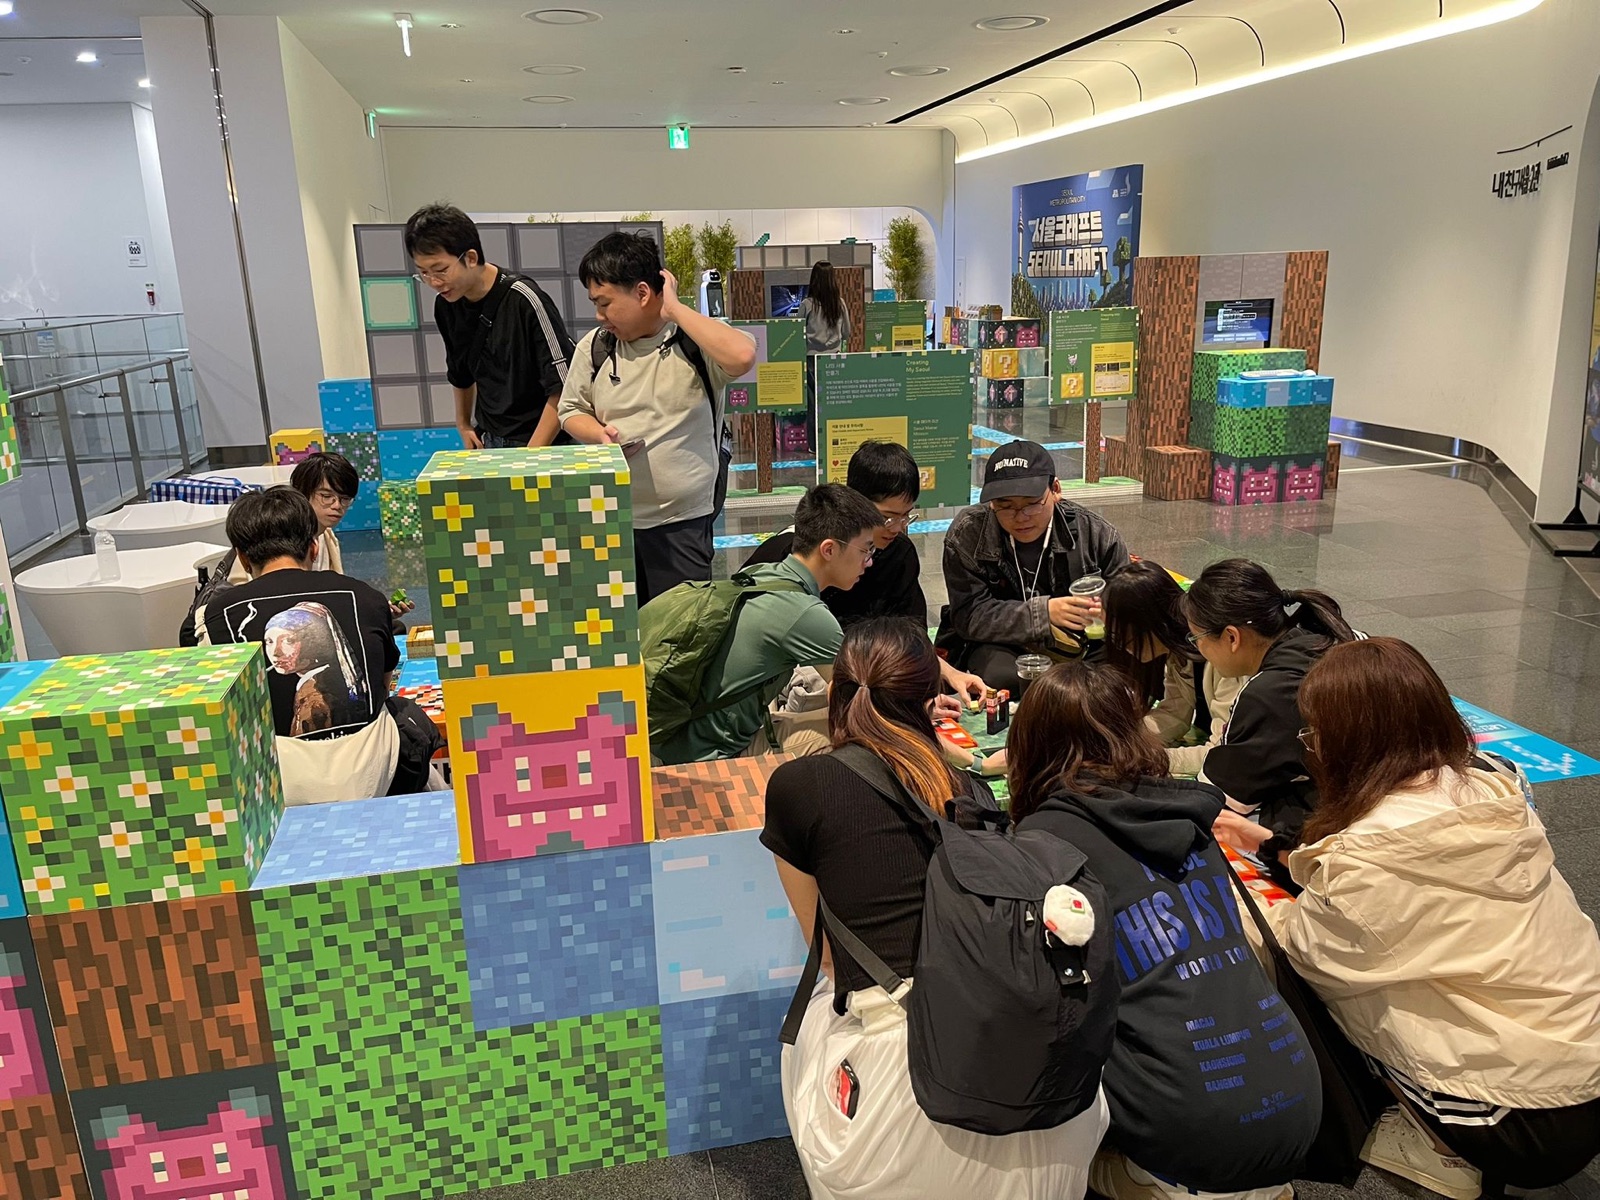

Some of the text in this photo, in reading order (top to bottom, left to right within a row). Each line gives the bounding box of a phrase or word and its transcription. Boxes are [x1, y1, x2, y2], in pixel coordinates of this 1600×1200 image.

[1027, 247, 1109, 278] SEOULCRAFT
[1177, 879, 1226, 942] IS
[1175, 953, 1224, 981] WORLD
[1192, 1037, 1220, 1051] KUALA
[1219, 1028, 1252, 1046] LUMPUR
[1204, 1074, 1246, 1092] BANGKOK
